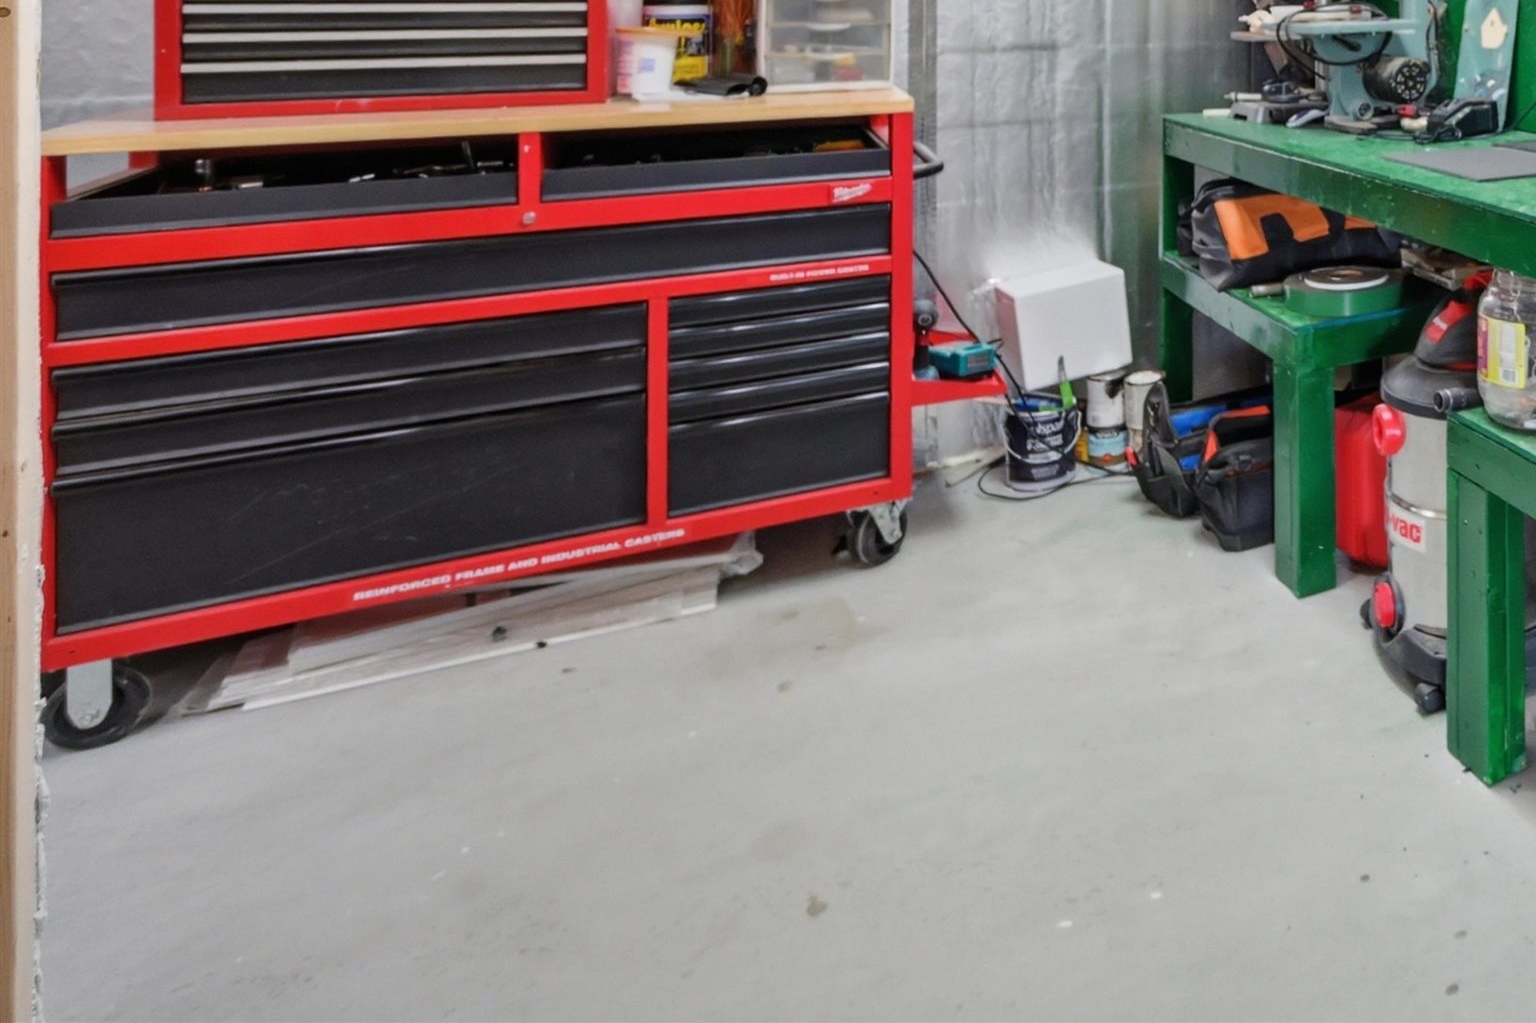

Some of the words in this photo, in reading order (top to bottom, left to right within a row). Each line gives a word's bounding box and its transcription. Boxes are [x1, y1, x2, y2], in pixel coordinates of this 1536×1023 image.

[353, 574, 453, 601] REINFORCED
[455, 563, 505, 582] FRAME
[507, 557, 539, 571] AND
[541, 540, 622, 565] INDUSTRIAL
[624, 528, 686, 549] CASTERS
